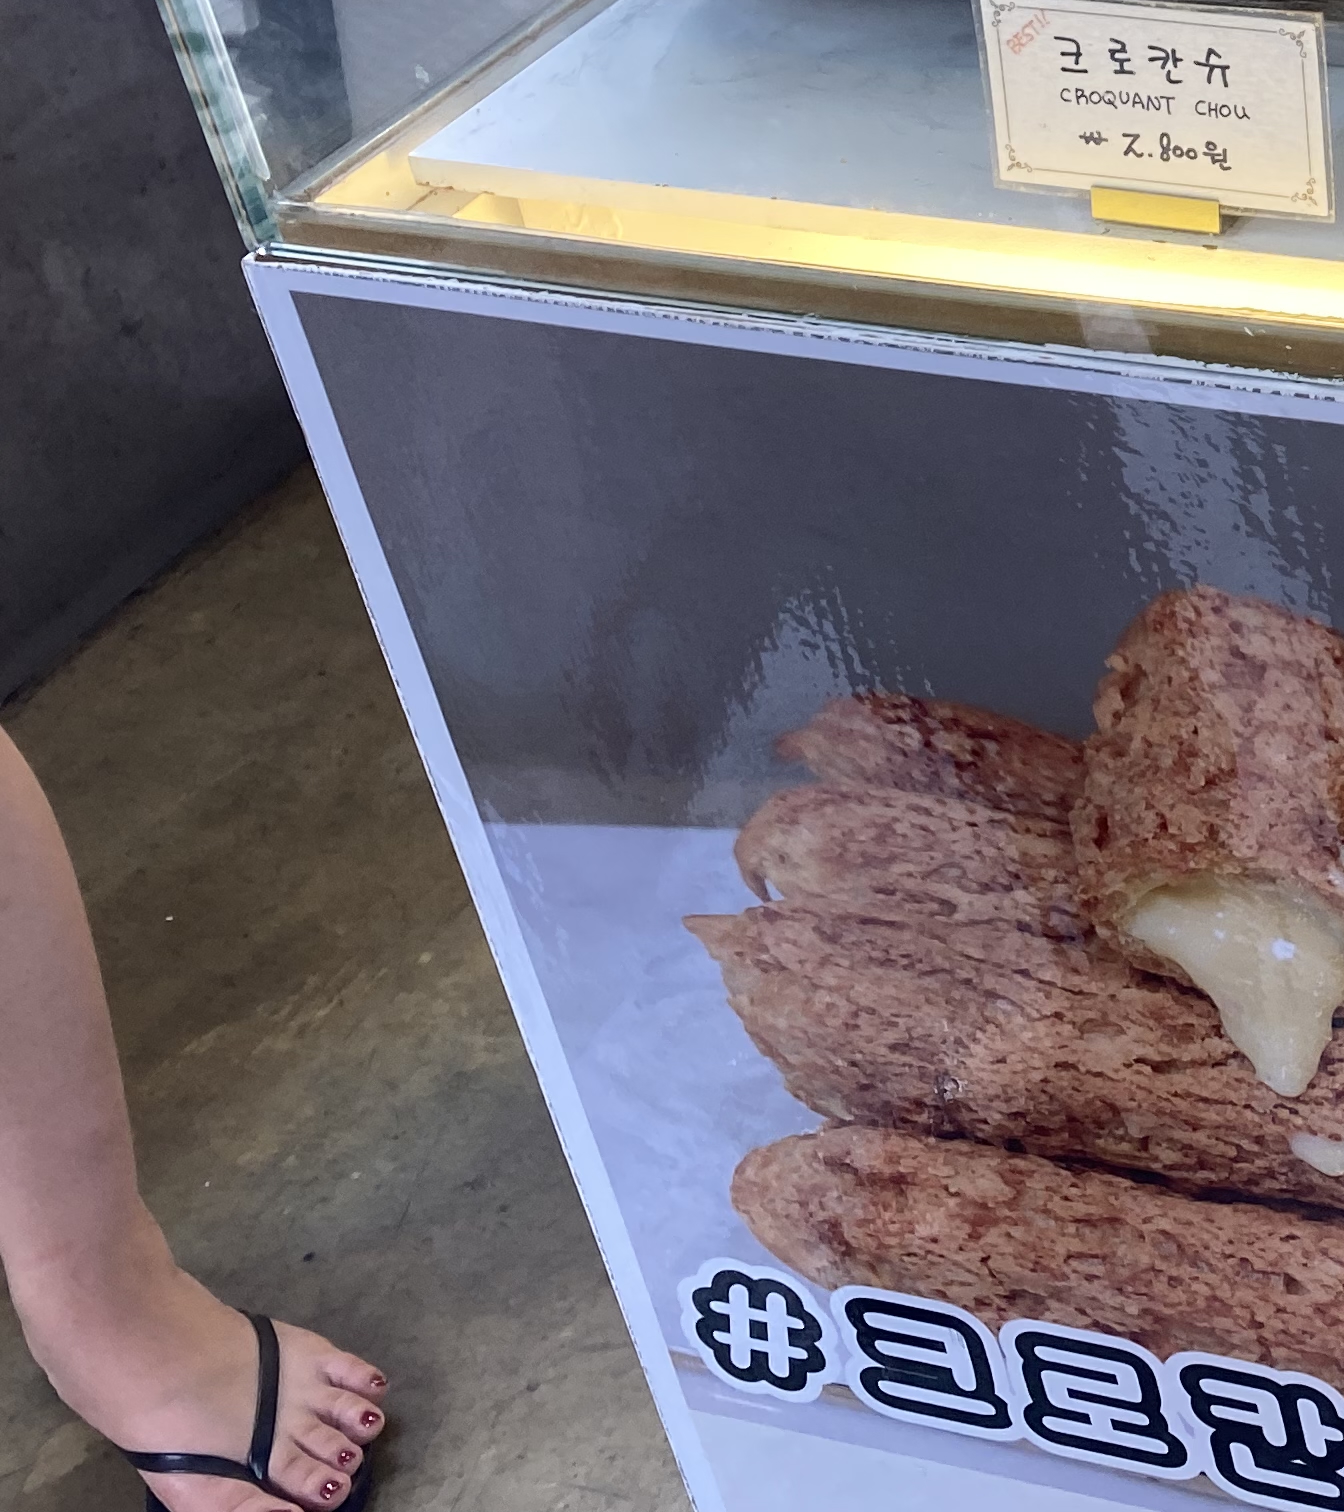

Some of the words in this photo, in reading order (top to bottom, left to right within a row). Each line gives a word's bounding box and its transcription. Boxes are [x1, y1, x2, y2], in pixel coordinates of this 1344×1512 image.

[1006, 9, 1050, 56] BEST!!
[1054, 35, 1230, 88] 크로칸슈
[1060, 87, 1176, 115] CROQUANT
